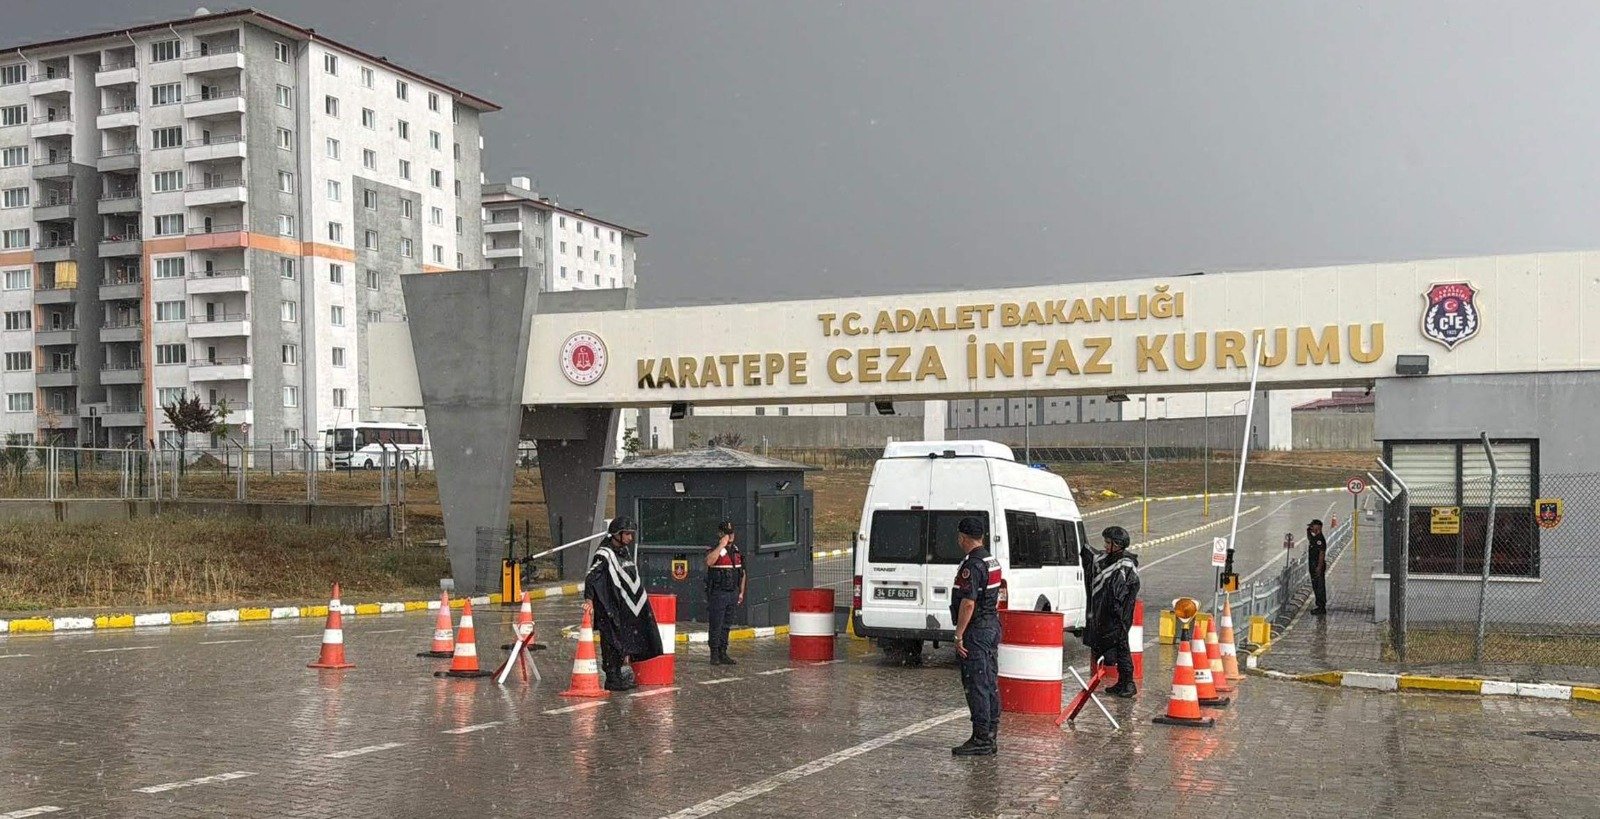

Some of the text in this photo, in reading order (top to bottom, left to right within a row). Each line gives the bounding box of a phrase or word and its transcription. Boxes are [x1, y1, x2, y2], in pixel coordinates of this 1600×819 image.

[818, 285, 1185, 337] T.C. ADALET BAKANLIĞI
[1440, 313, 1463, 329] CTE
[637, 322, 1385, 389] KARATEPE CEZA İNFAZ KURUMU
[1351, 481, 1362, 490] 20
[877, 589, 885, 597] 34
